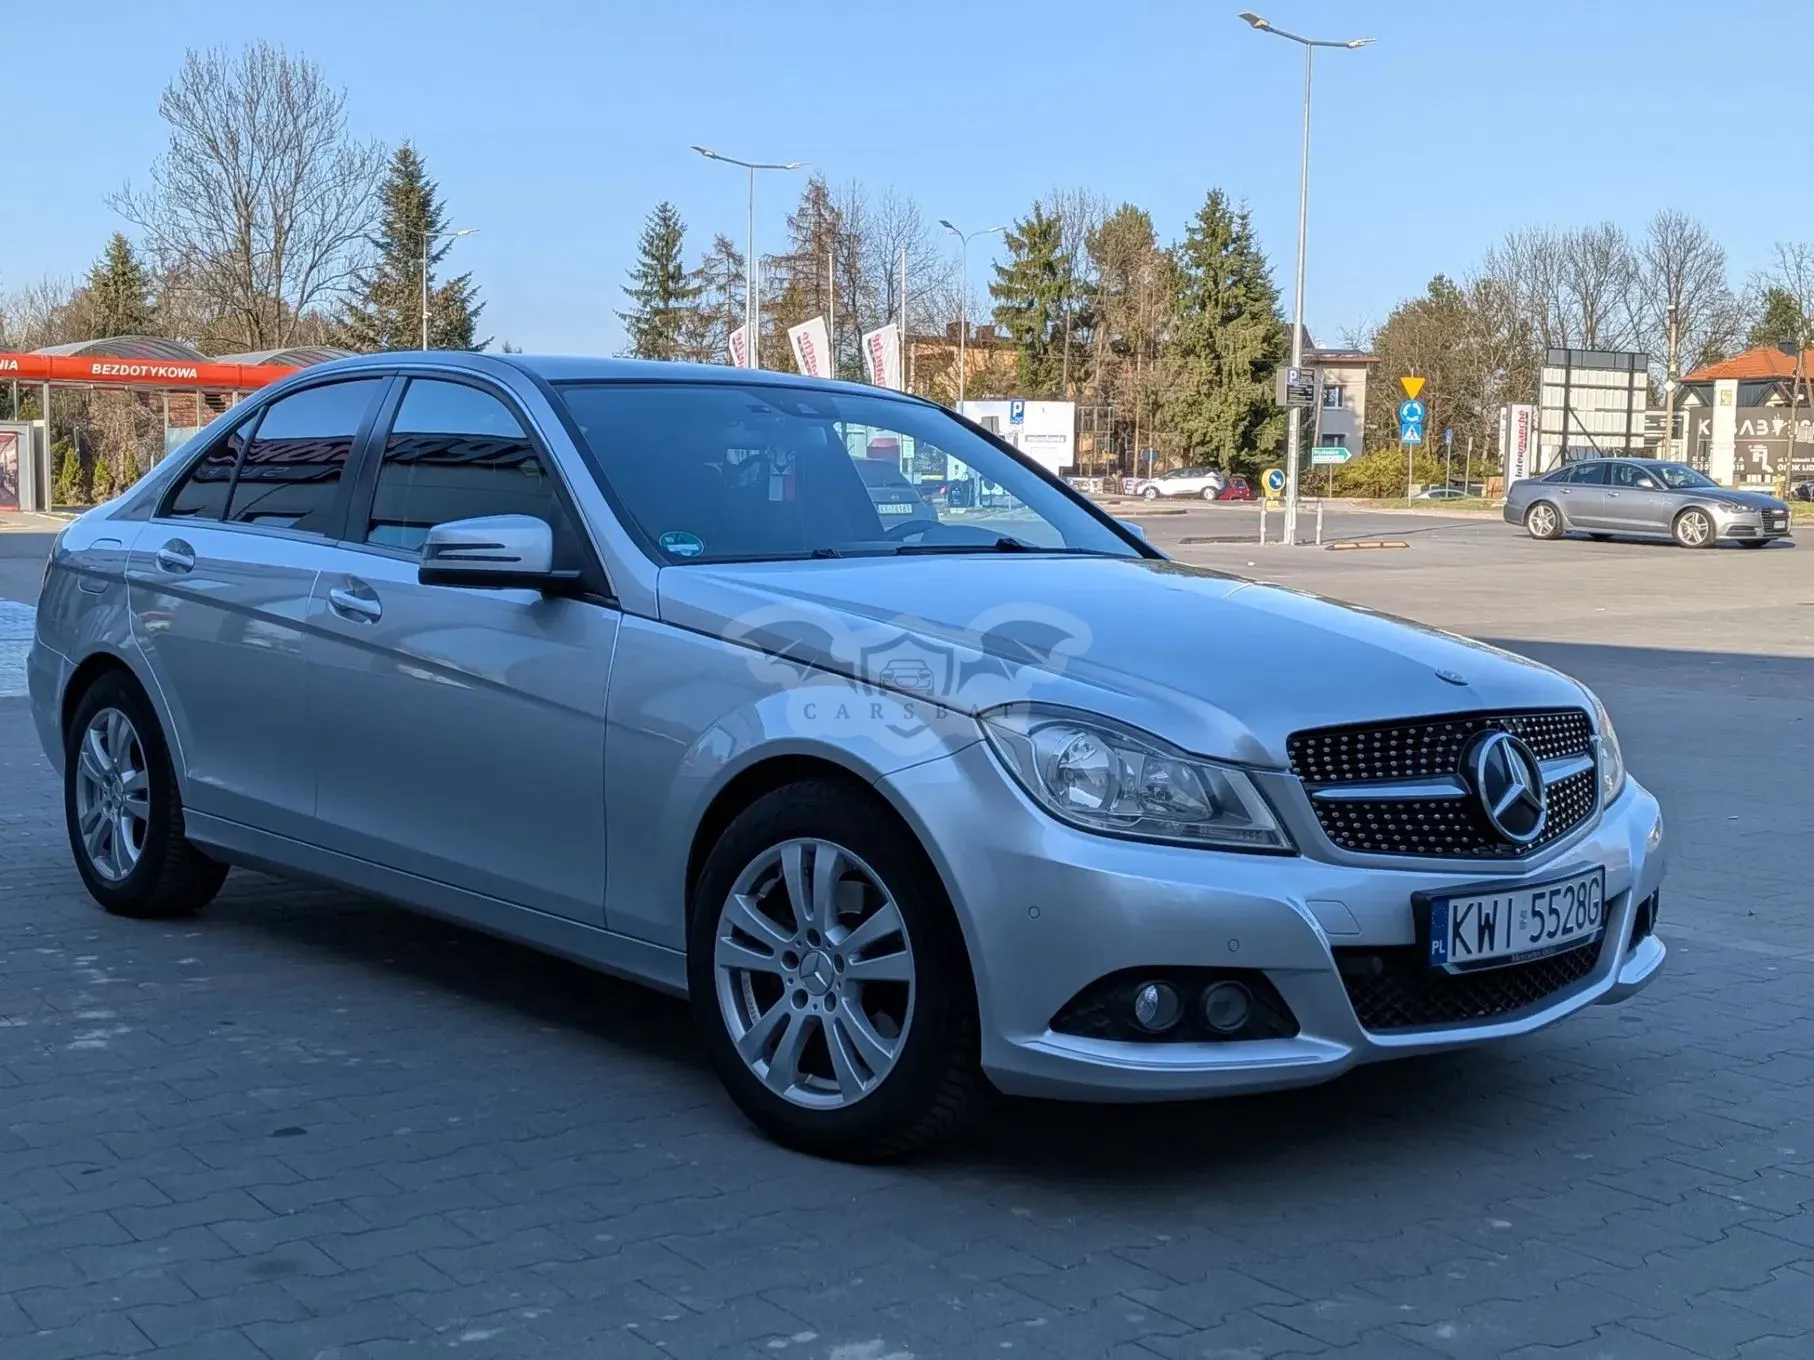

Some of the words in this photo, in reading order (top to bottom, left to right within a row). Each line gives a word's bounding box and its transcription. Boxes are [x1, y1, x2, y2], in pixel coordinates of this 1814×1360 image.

[91, 363, 198, 379] BEZDOTYKOWA
[1012, 401, 1023, 418] P
[1699, 419, 1769, 436] KAB
[1451, 898, 1513, 957] KWI
[1529, 876, 1600, 944] 5528G
[1431, 939, 1446, 955] PL
